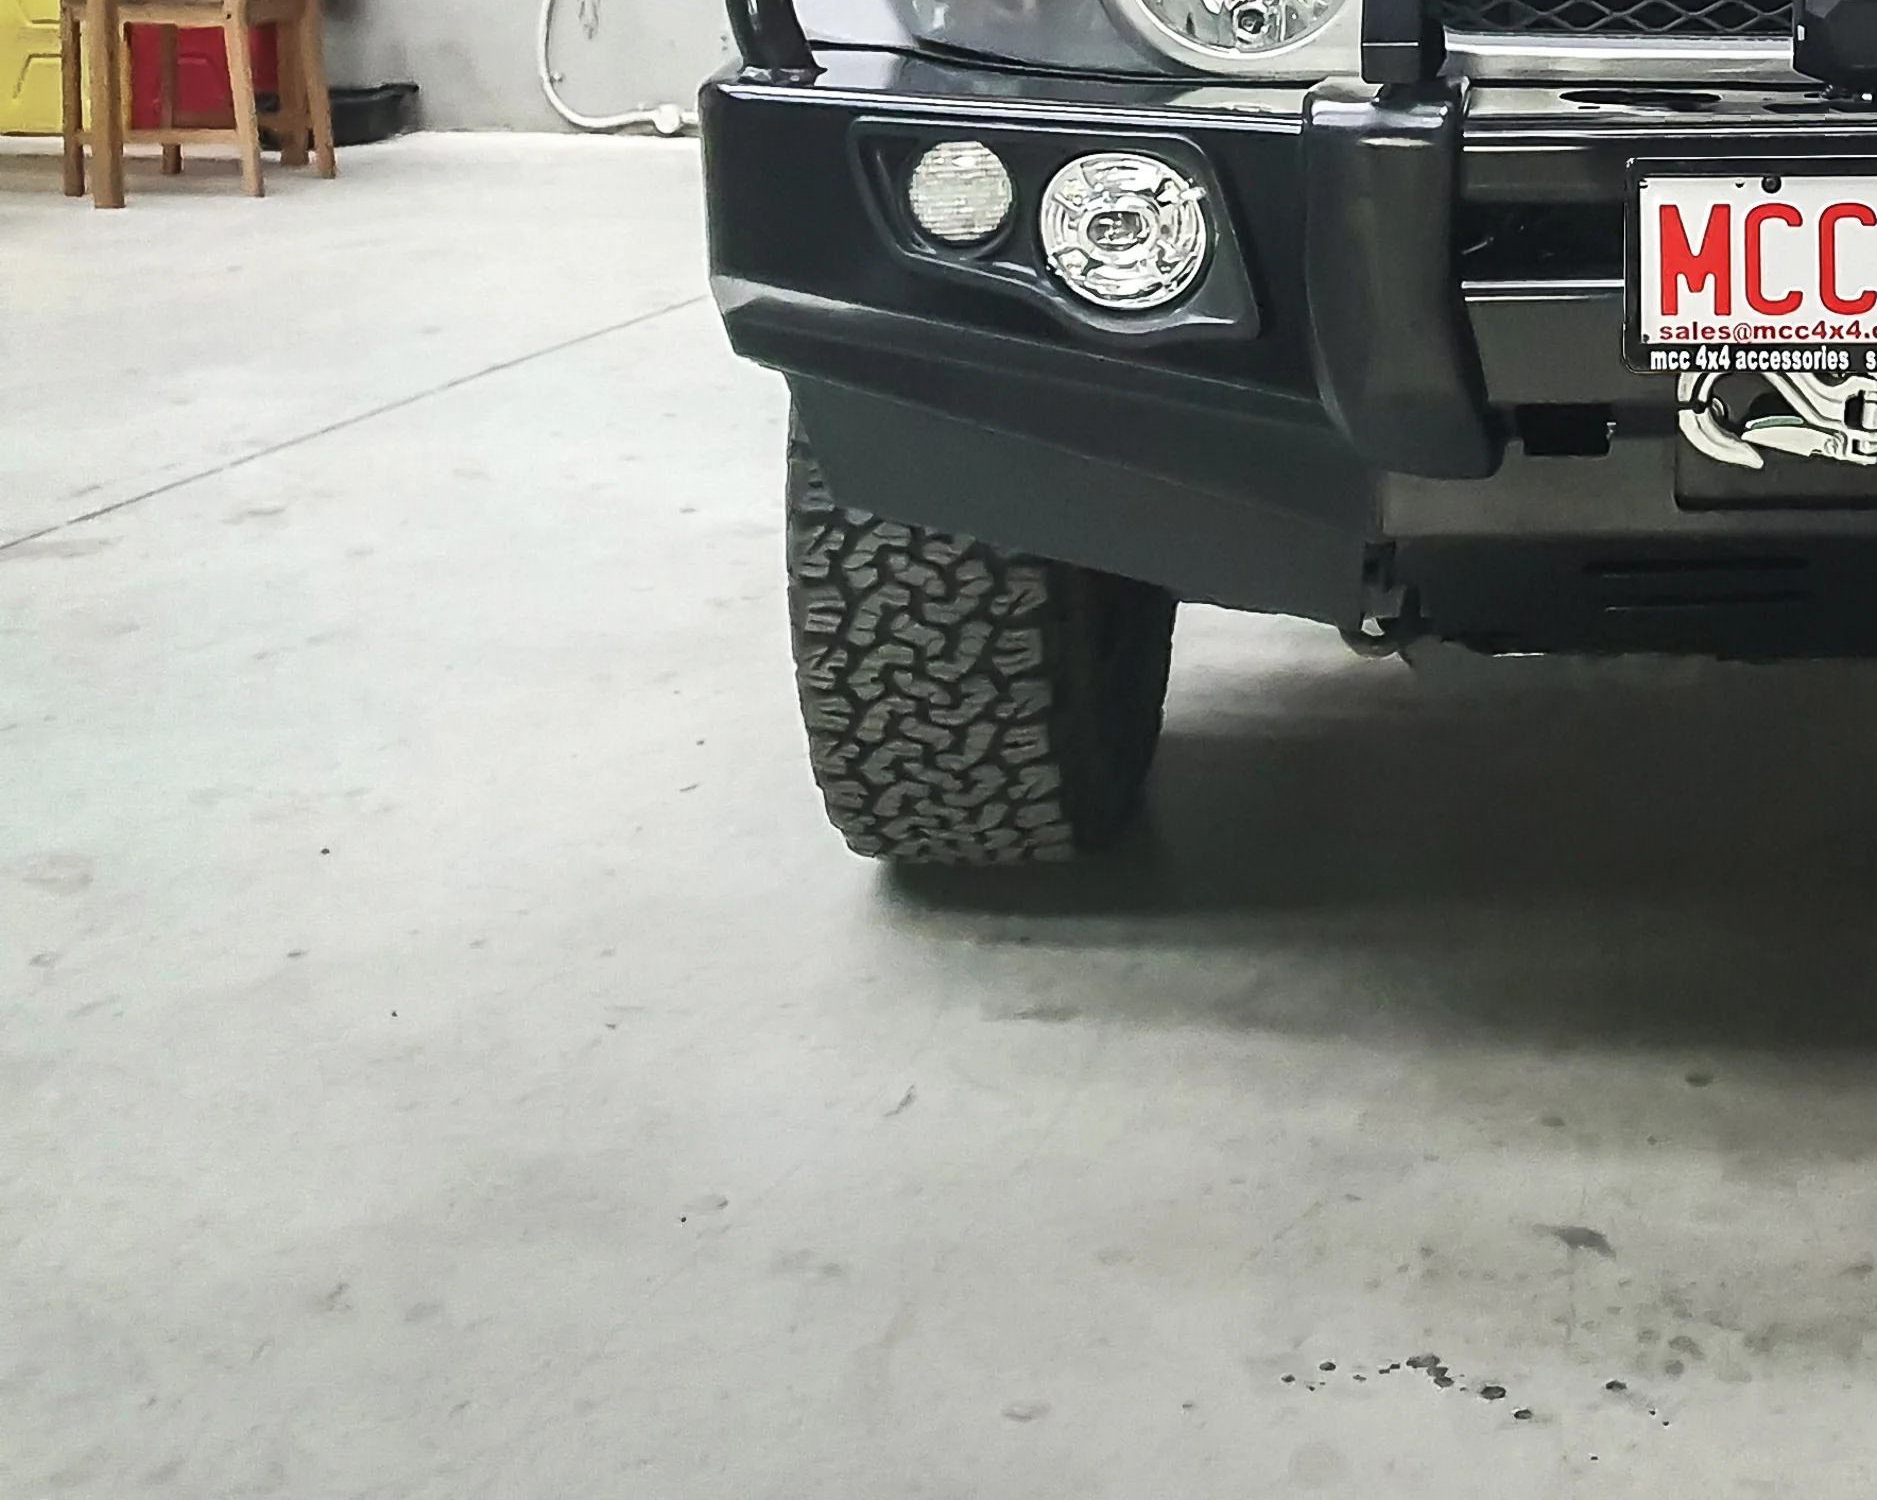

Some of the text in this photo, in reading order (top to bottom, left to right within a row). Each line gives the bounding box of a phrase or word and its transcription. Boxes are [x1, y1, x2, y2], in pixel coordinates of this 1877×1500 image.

[1659, 202, 1877, 317] MCC
[1650, 349, 1691, 371] mcc
[1695, 345, 1731, 371] 4x4
[1735, 345, 1850, 371] accessories
